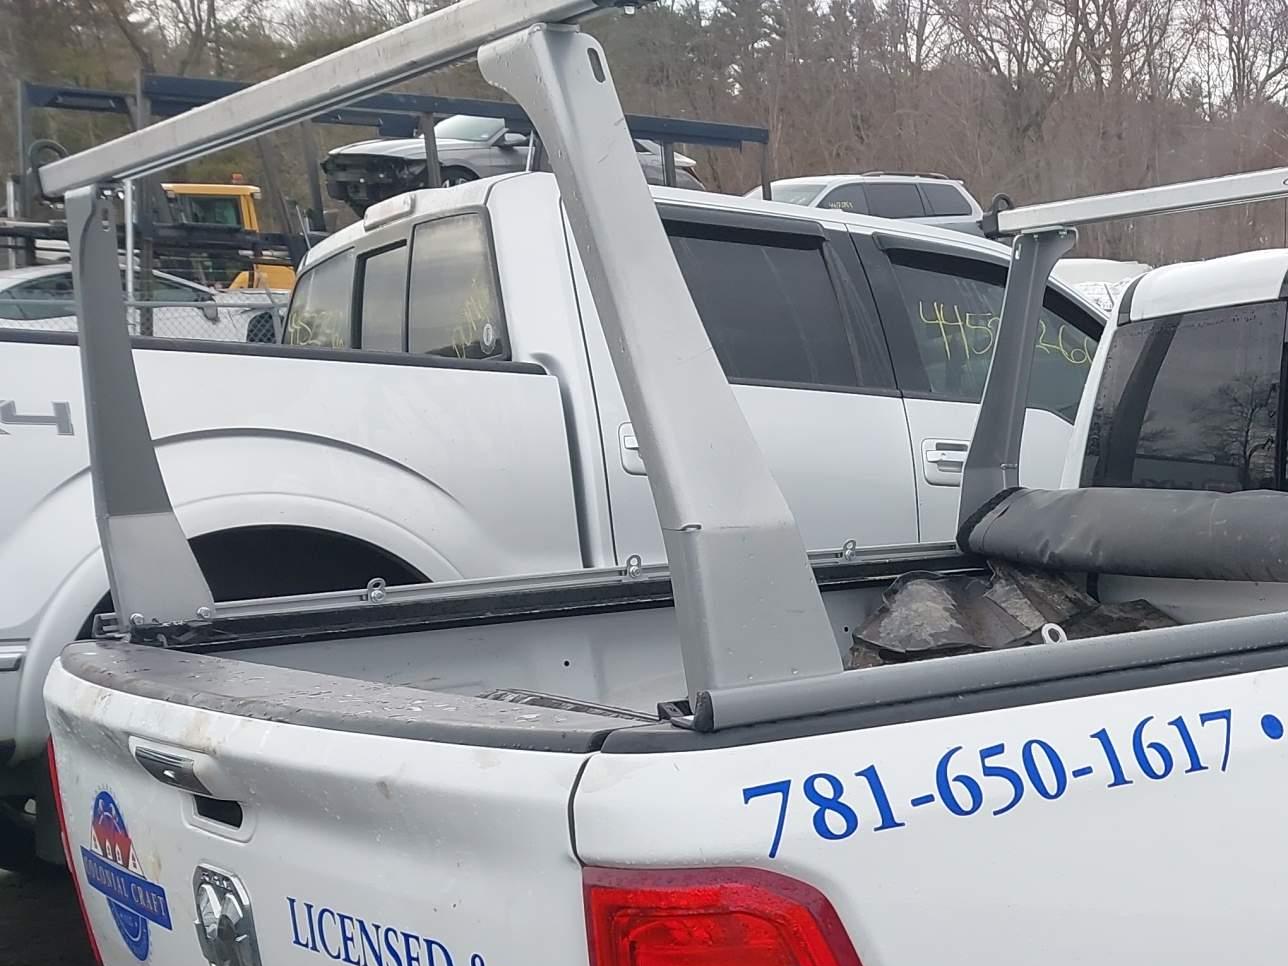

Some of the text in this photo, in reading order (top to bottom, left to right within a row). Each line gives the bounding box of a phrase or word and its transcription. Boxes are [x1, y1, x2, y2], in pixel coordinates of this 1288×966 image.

[743, 708, 1233, 860] 781-650-1617
[83, 855, 167, 917] COLONIAL CRAFT
